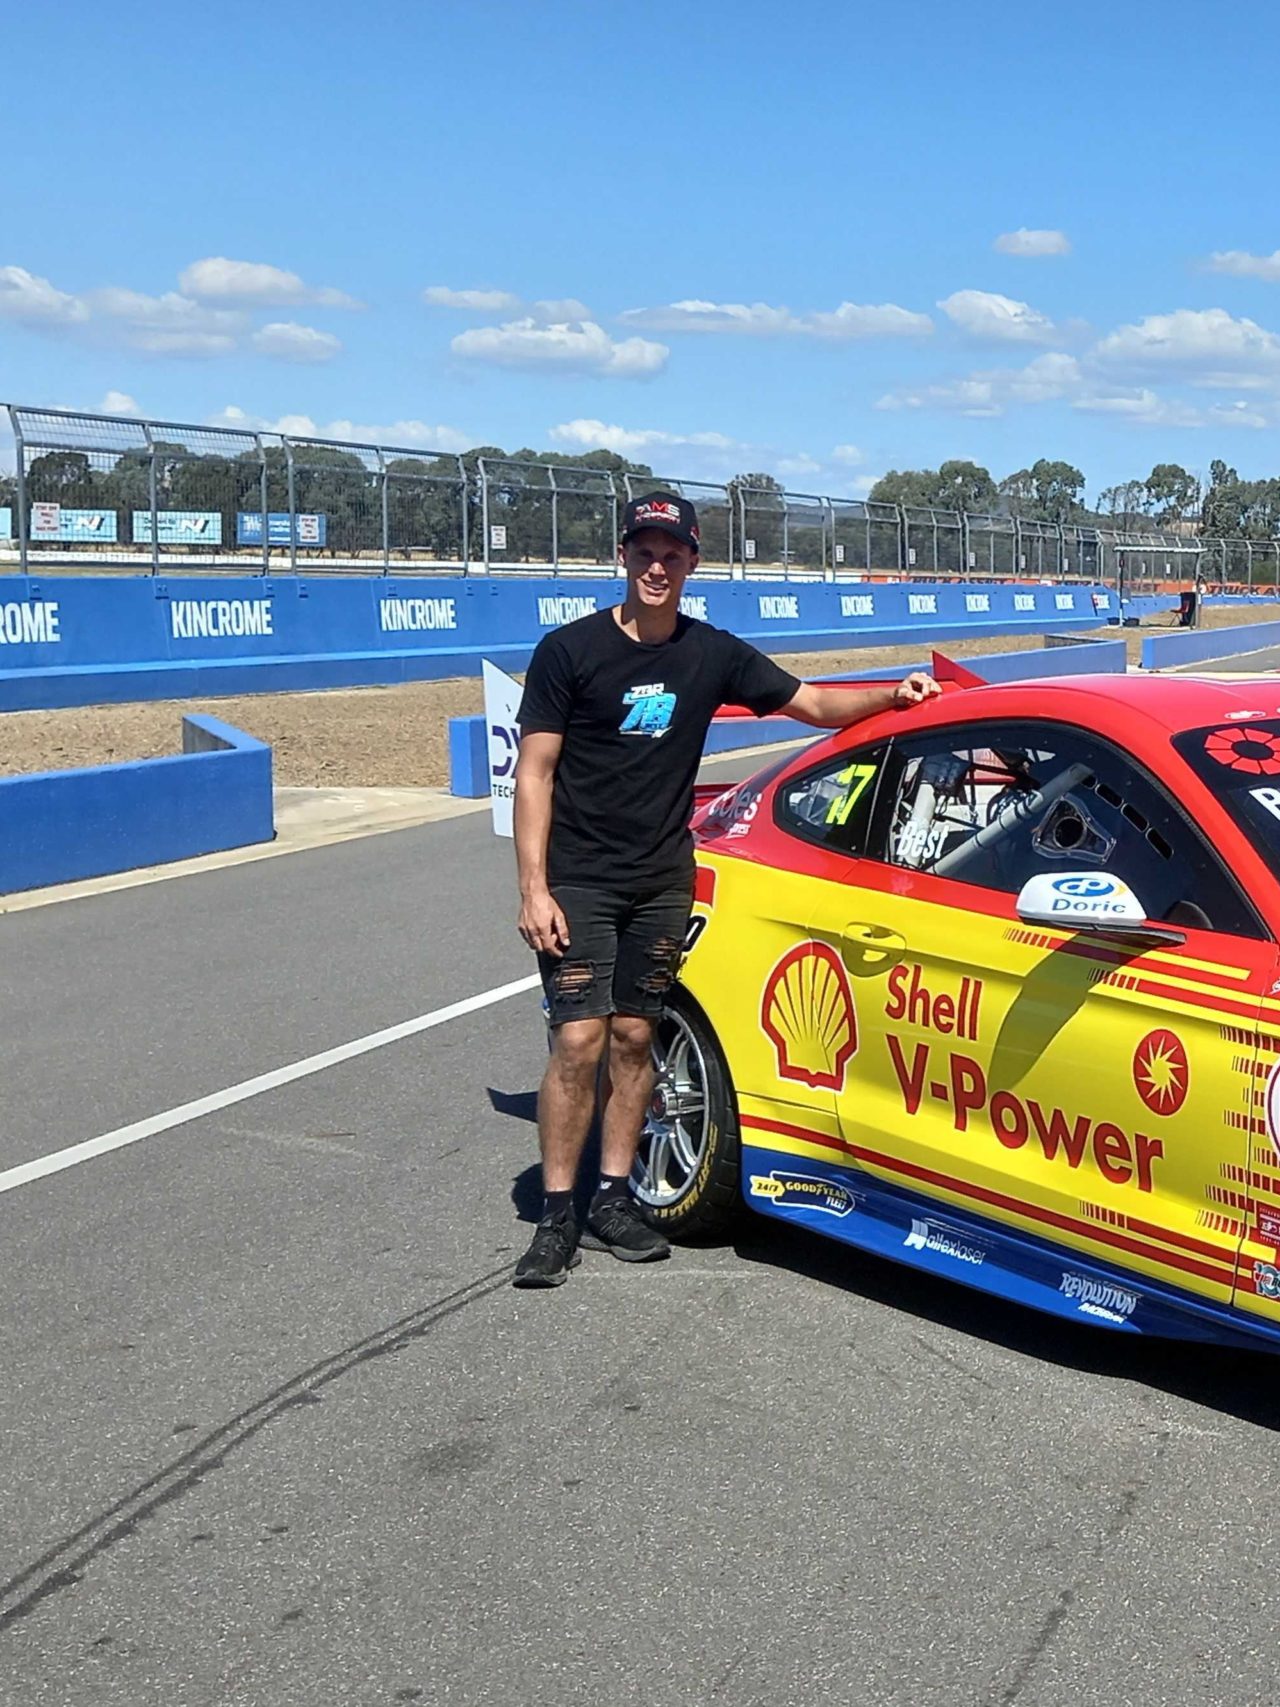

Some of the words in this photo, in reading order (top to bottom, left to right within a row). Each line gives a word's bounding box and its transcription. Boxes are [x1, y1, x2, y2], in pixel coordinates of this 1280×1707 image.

[171, 600, 274, 638] KINCROME
[380, 599, 457, 631] KINCROME
[826, 764, 877, 825] 17
[896, 820, 949, 859] Best
[1052, 898, 1126, 914] Doric
[885, 964, 983, 1041] Shell
[886, 1033, 1164, 1193] V-Power
[756, 1182, 779, 1193] 24/7
[785, 1181, 848, 1200] GOODYEAR
[825, 1196, 847, 1210] FLEET
[1059, 1272, 1137, 1315] REVOLUTION
